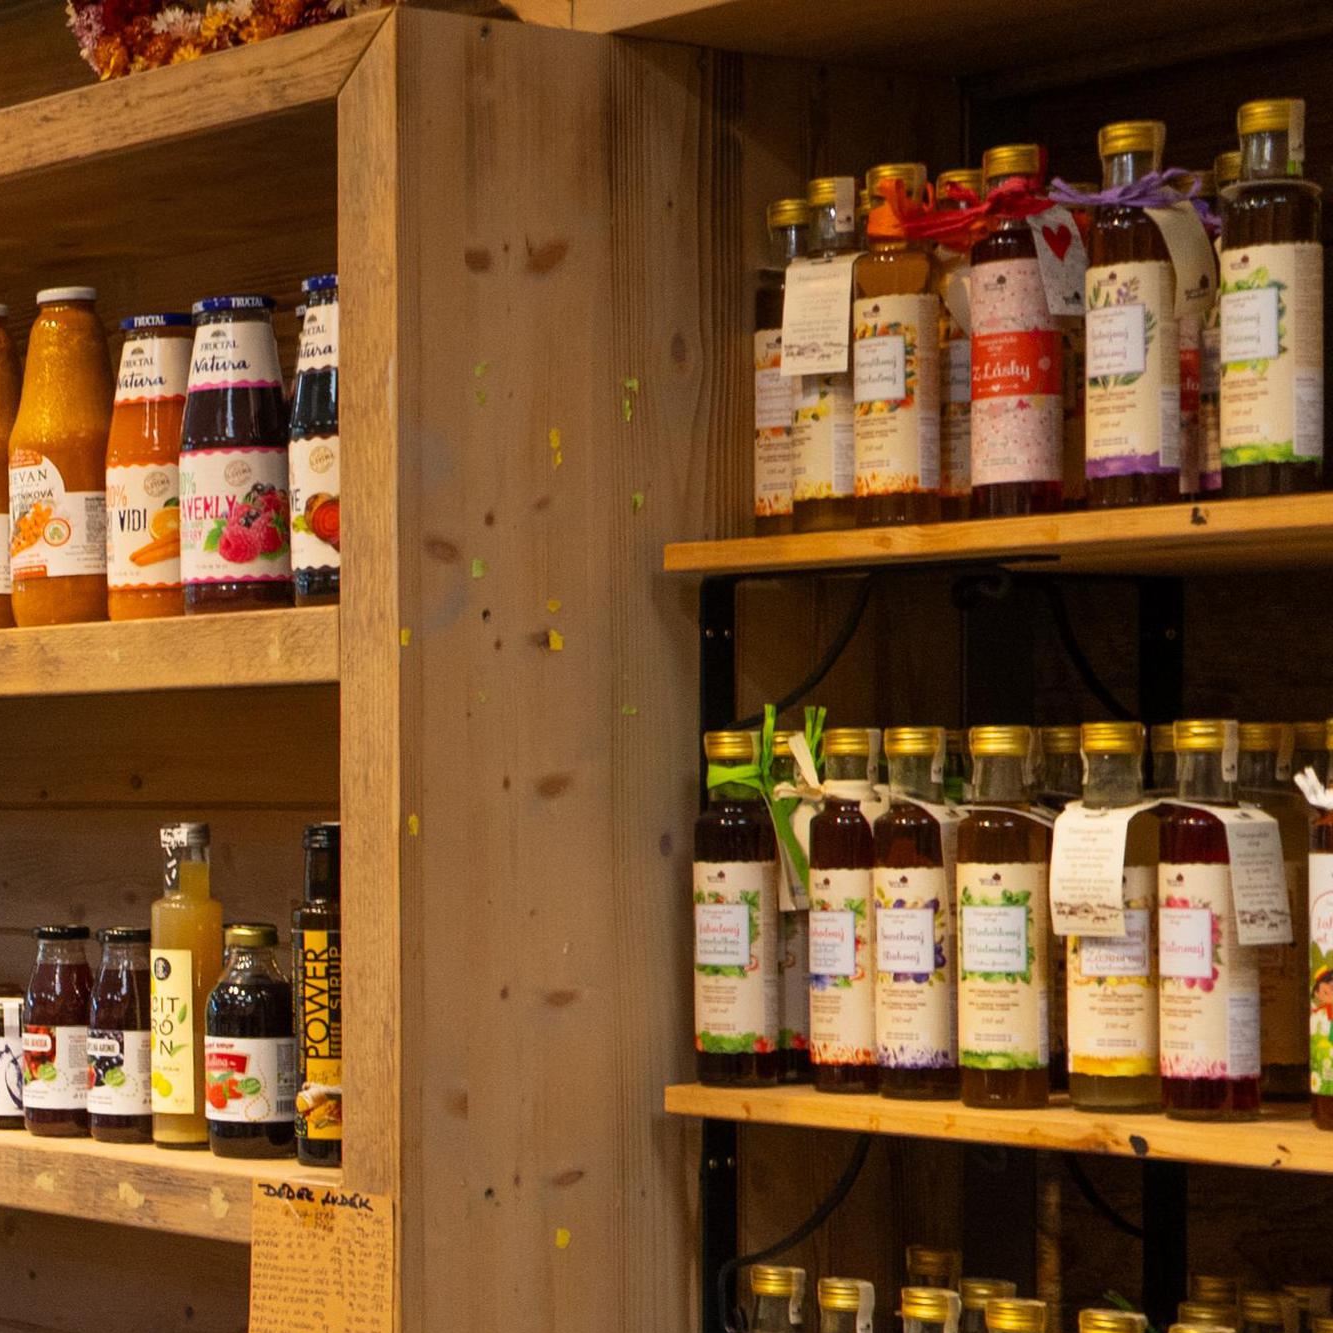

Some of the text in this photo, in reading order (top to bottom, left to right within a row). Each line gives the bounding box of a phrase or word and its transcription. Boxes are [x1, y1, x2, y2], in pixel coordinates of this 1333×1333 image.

[231, 297, 263, 307] FRUCTAL
[134, 315, 166, 327] FRUCTAL
[193, 354, 251, 373] Natura
[983, 361, 1031, 381] Lásky
[118, 508, 147, 532] VIDI
[306, 948, 329, 1059] POWER
